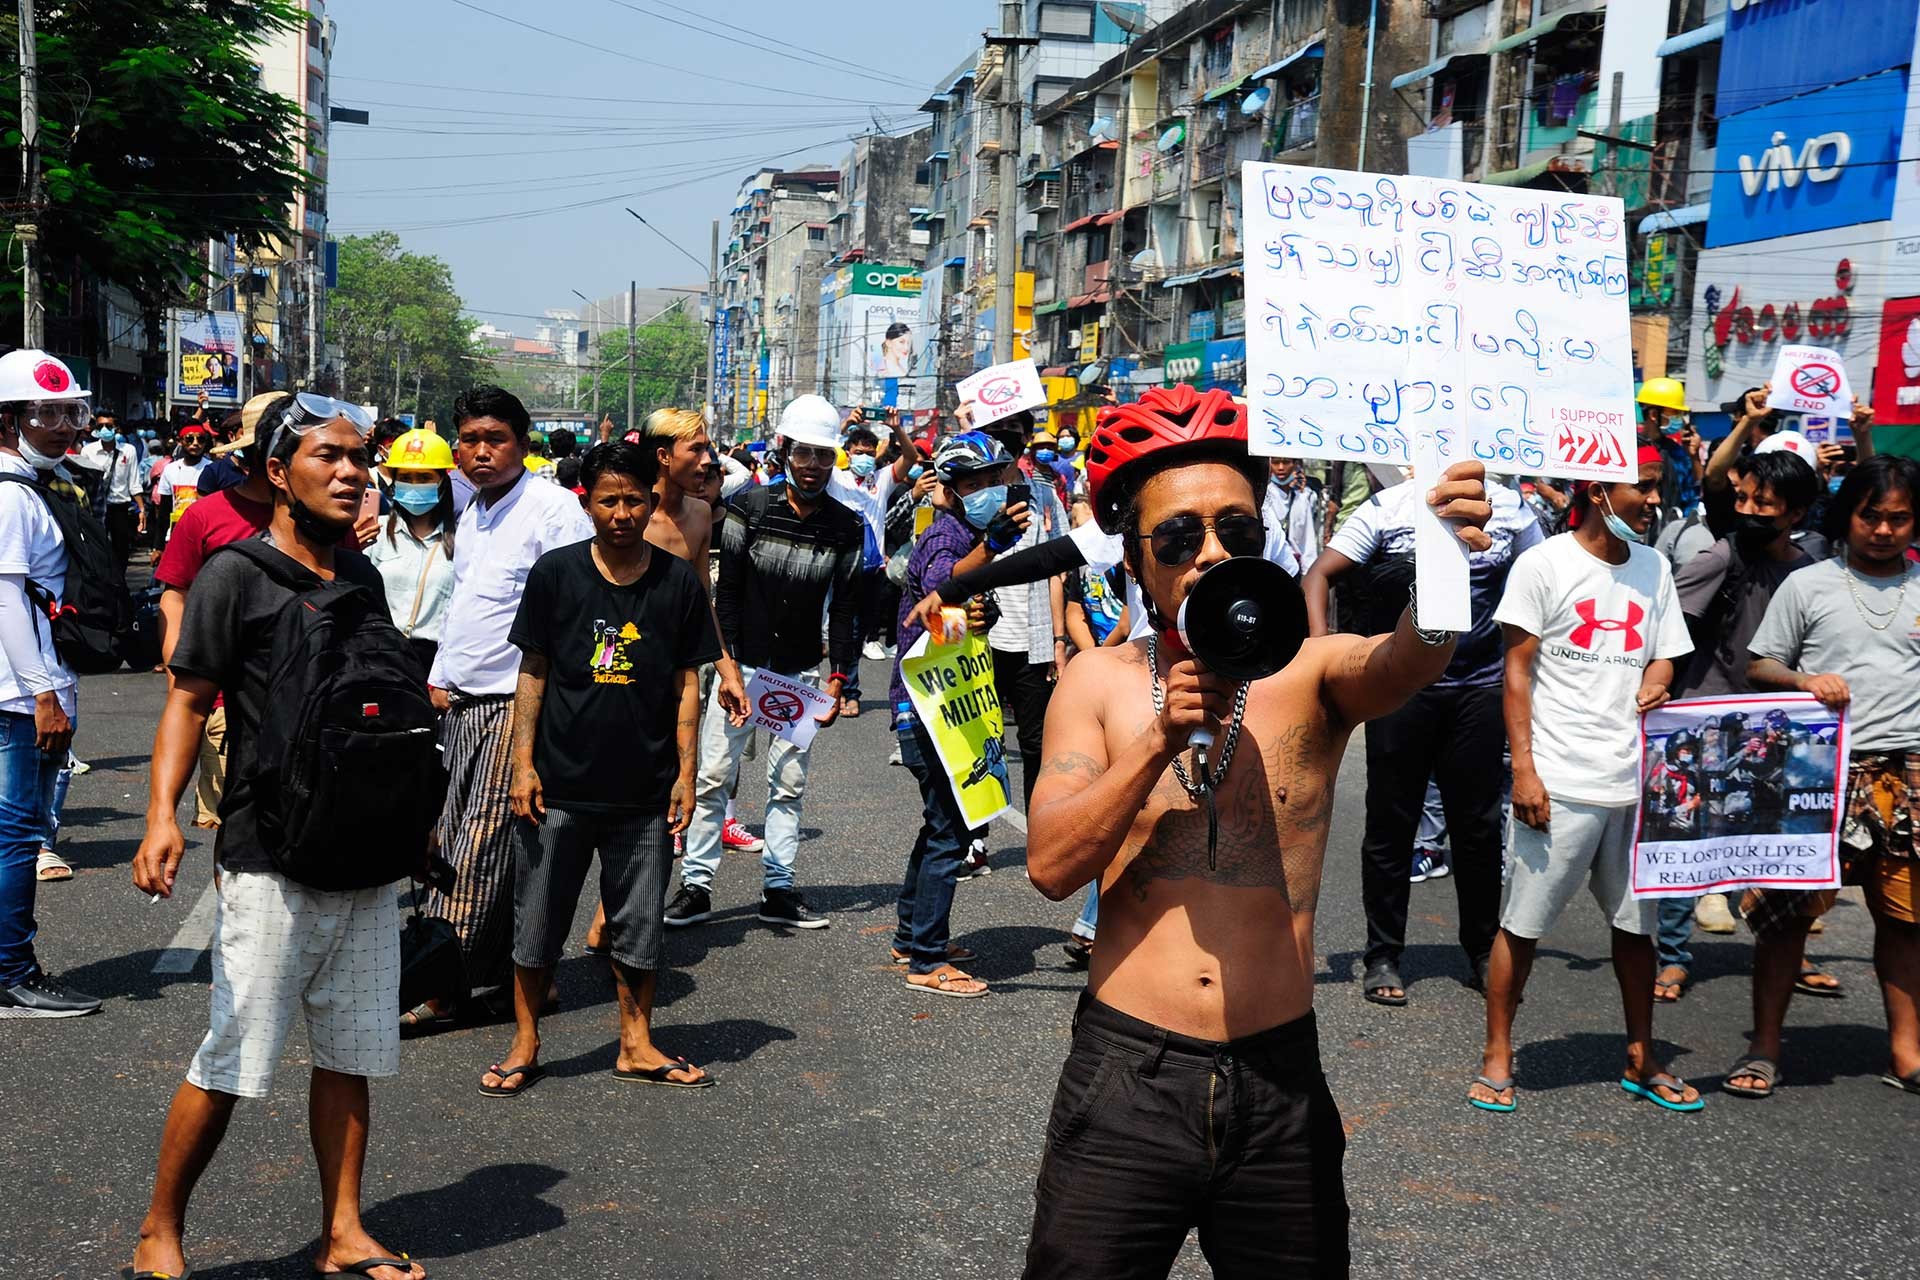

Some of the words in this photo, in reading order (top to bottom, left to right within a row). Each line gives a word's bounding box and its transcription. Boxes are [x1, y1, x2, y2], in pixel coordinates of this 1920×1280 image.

[1738, 131, 1850, 196] vivo
[869, 304, 894, 316] OPPO
[991, 402, 1019, 417] END
[1793, 398, 1826, 411] END
[1551, 407, 1555, 419] I
[1560, 408, 1624, 426] SUPPORT
[1550, 645, 1600, 663] UNDER
[758, 674, 800, 692] MILITARY
[799, 689, 828, 704] COUP
[917, 665, 957, 695] We
[755, 716, 784, 732] END
[1646, 852, 1679, 865] WE
[1682, 847, 1721, 864] LOST
[1722, 844, 1759, 859] OUR
[1765, 845, 1817, 857] LIVES
[1659, 870, 1706, 885] REAL
[1707, 865, 1739, 882] GUN
[1739, 864, 1806, 877] SHOTS
